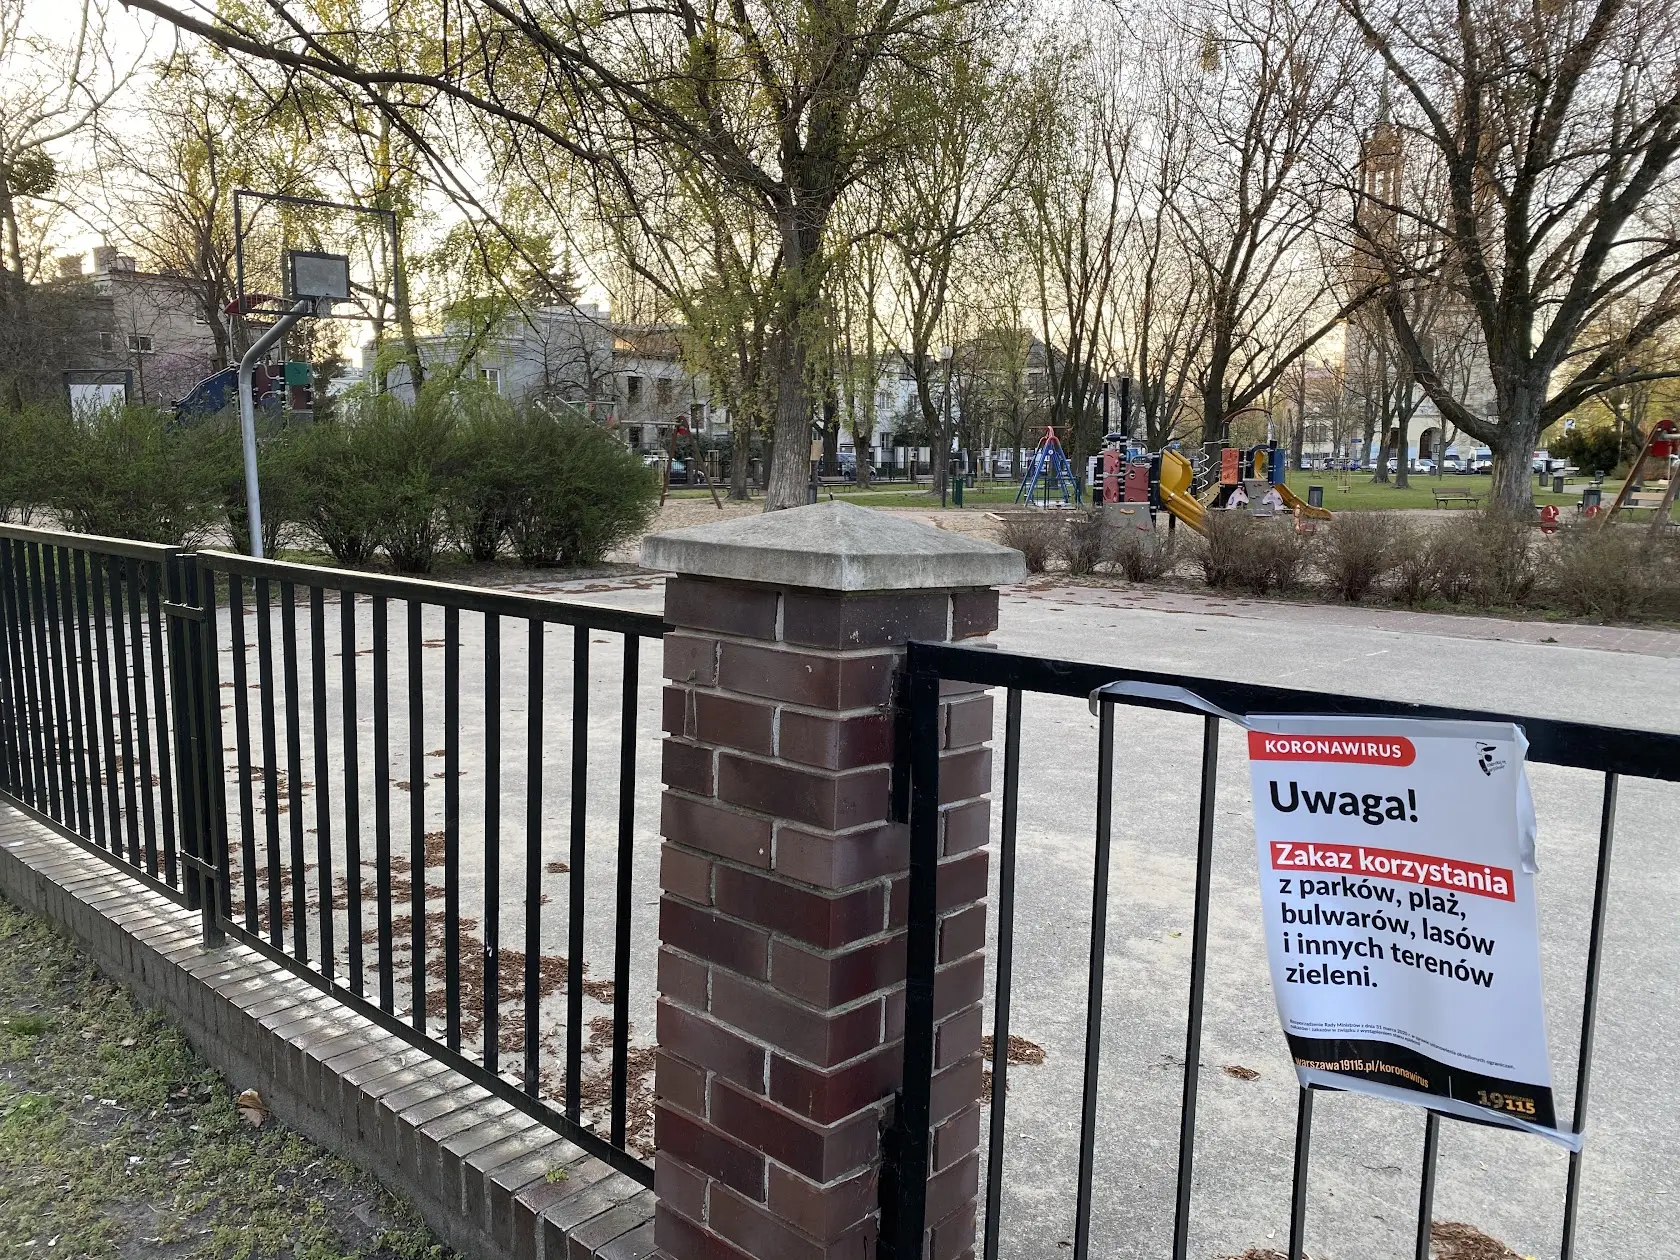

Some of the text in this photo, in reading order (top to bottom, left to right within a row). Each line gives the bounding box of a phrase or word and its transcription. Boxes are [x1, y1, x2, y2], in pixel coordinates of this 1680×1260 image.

[1265, 739, 1402, 759] KORONAWIRUS
[1269, 780, 1419, 826] Uwaga!
[1276, 843, 1509, 896] Zakaz korzystania
[1279, 876, 1466, 921] z parków, plaż,
[1281, 902, 1495, 956] bulwarów, lasów
[1283, 932, 1494, 988] i innych terenów
[1285, 963, 1378, 988] zieleni.
[1295, 1057, 1429, 1088] warszawa19115.pl/koronawirus
